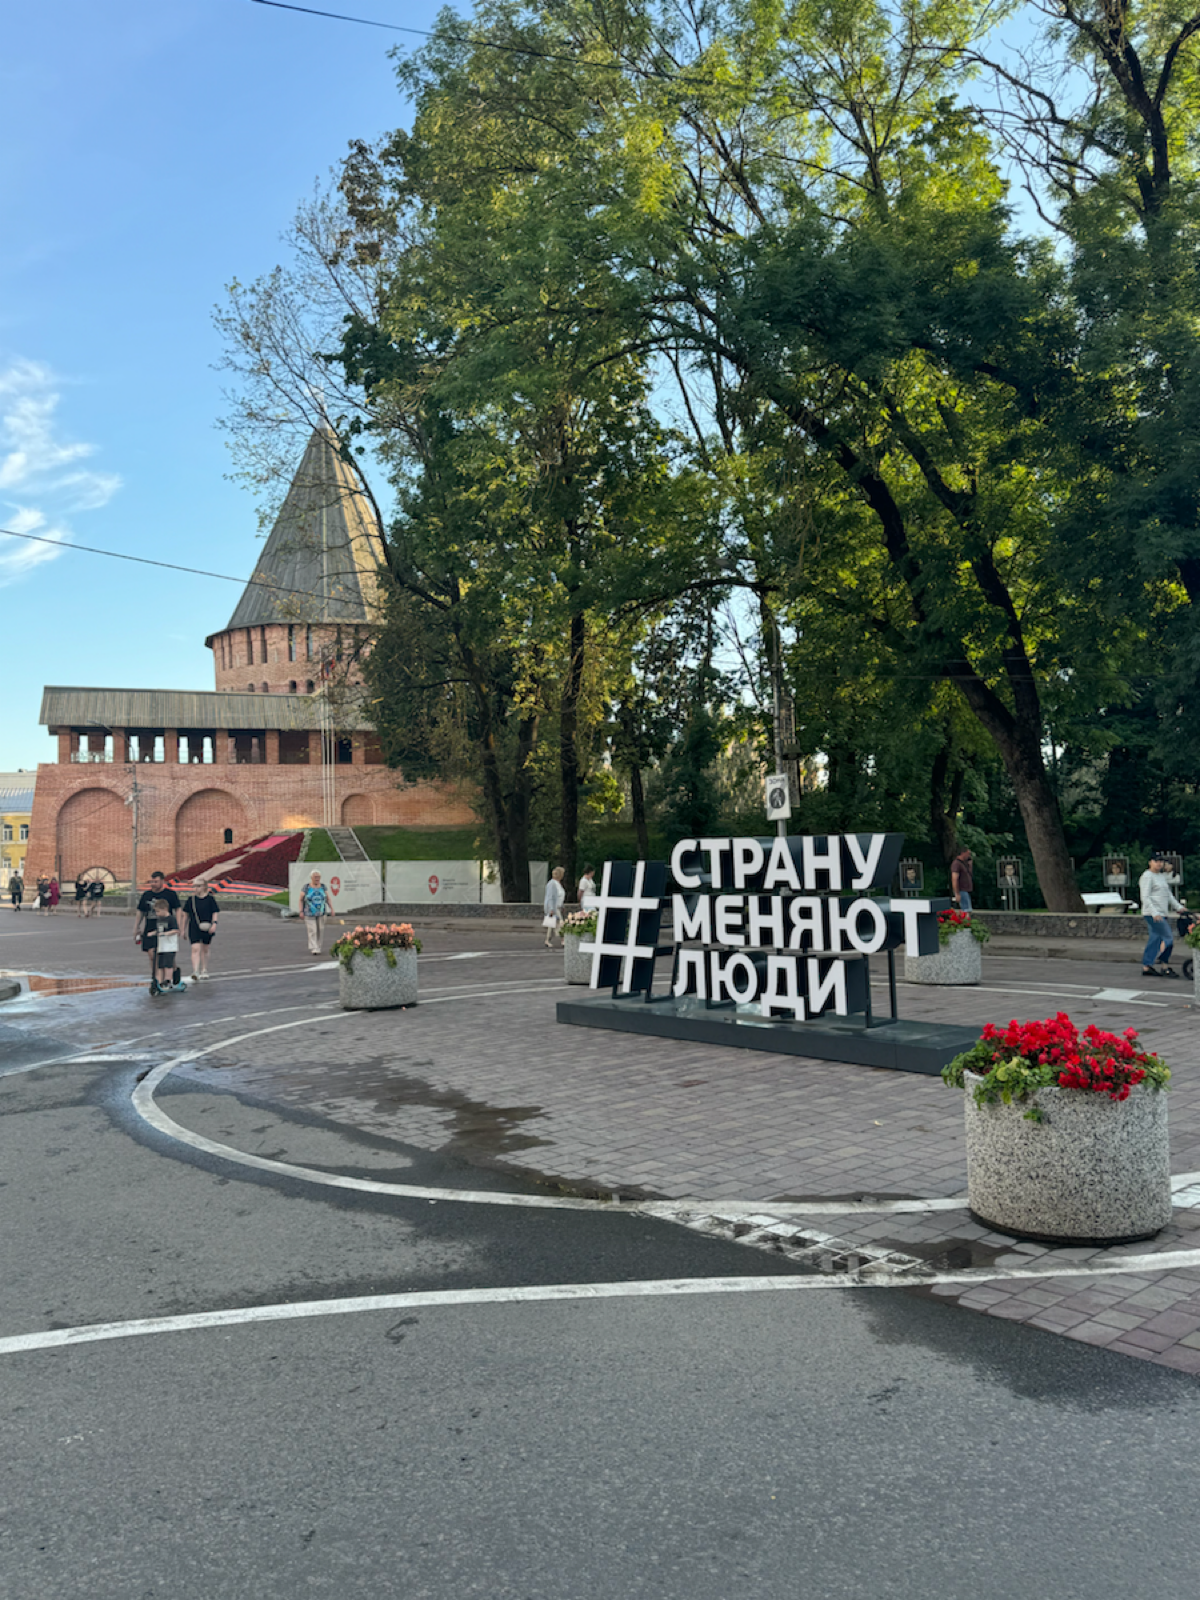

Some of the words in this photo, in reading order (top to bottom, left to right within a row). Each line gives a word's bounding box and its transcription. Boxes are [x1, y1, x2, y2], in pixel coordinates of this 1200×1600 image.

[671, 834, 886, 891] СТРАНУ
[672, 894, 931, 957] МЕНЯЮТ
[673, 949, 848, 1021] ЛЮДИ
